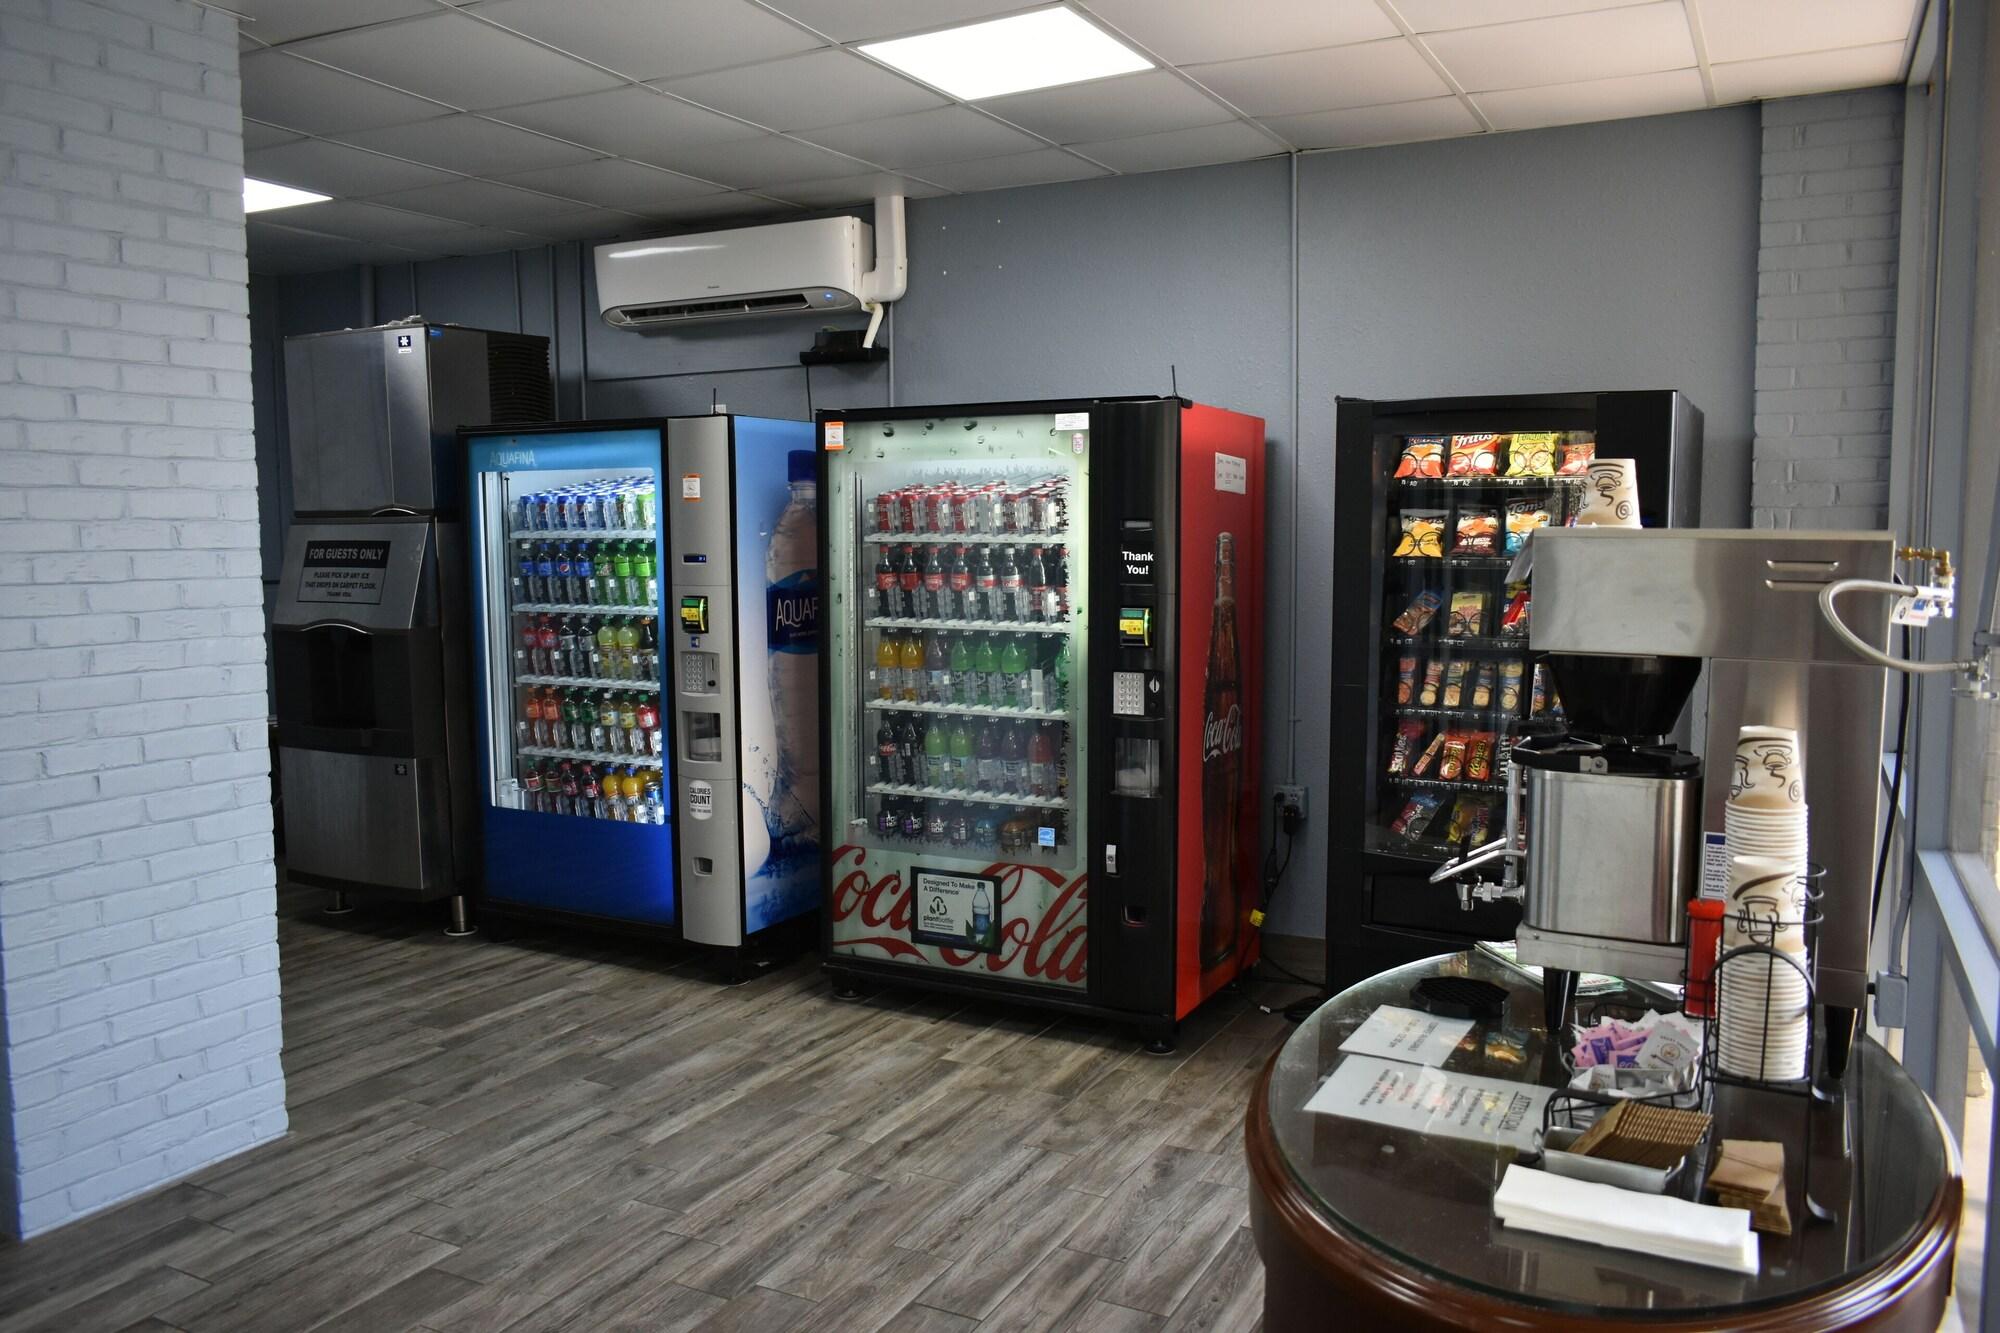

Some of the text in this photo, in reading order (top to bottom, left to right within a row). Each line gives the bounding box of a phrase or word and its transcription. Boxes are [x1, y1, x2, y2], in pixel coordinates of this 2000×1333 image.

[489, 449, 536, 467] AQUAFINA
[309, 548, 384, 560] FOR GUESTS ONLY
[1122, 550, 1154, 562] Thank
[1126, 564, 1149, 575] You!
[690, 794, 711, 804] COUNT
[923, 878, 950, 887] Designed
[959, 882, 975, 890] Make
[929, 886, 960, 895] Difference
[1501, 1094, 1533, 1131] ATTENTION
